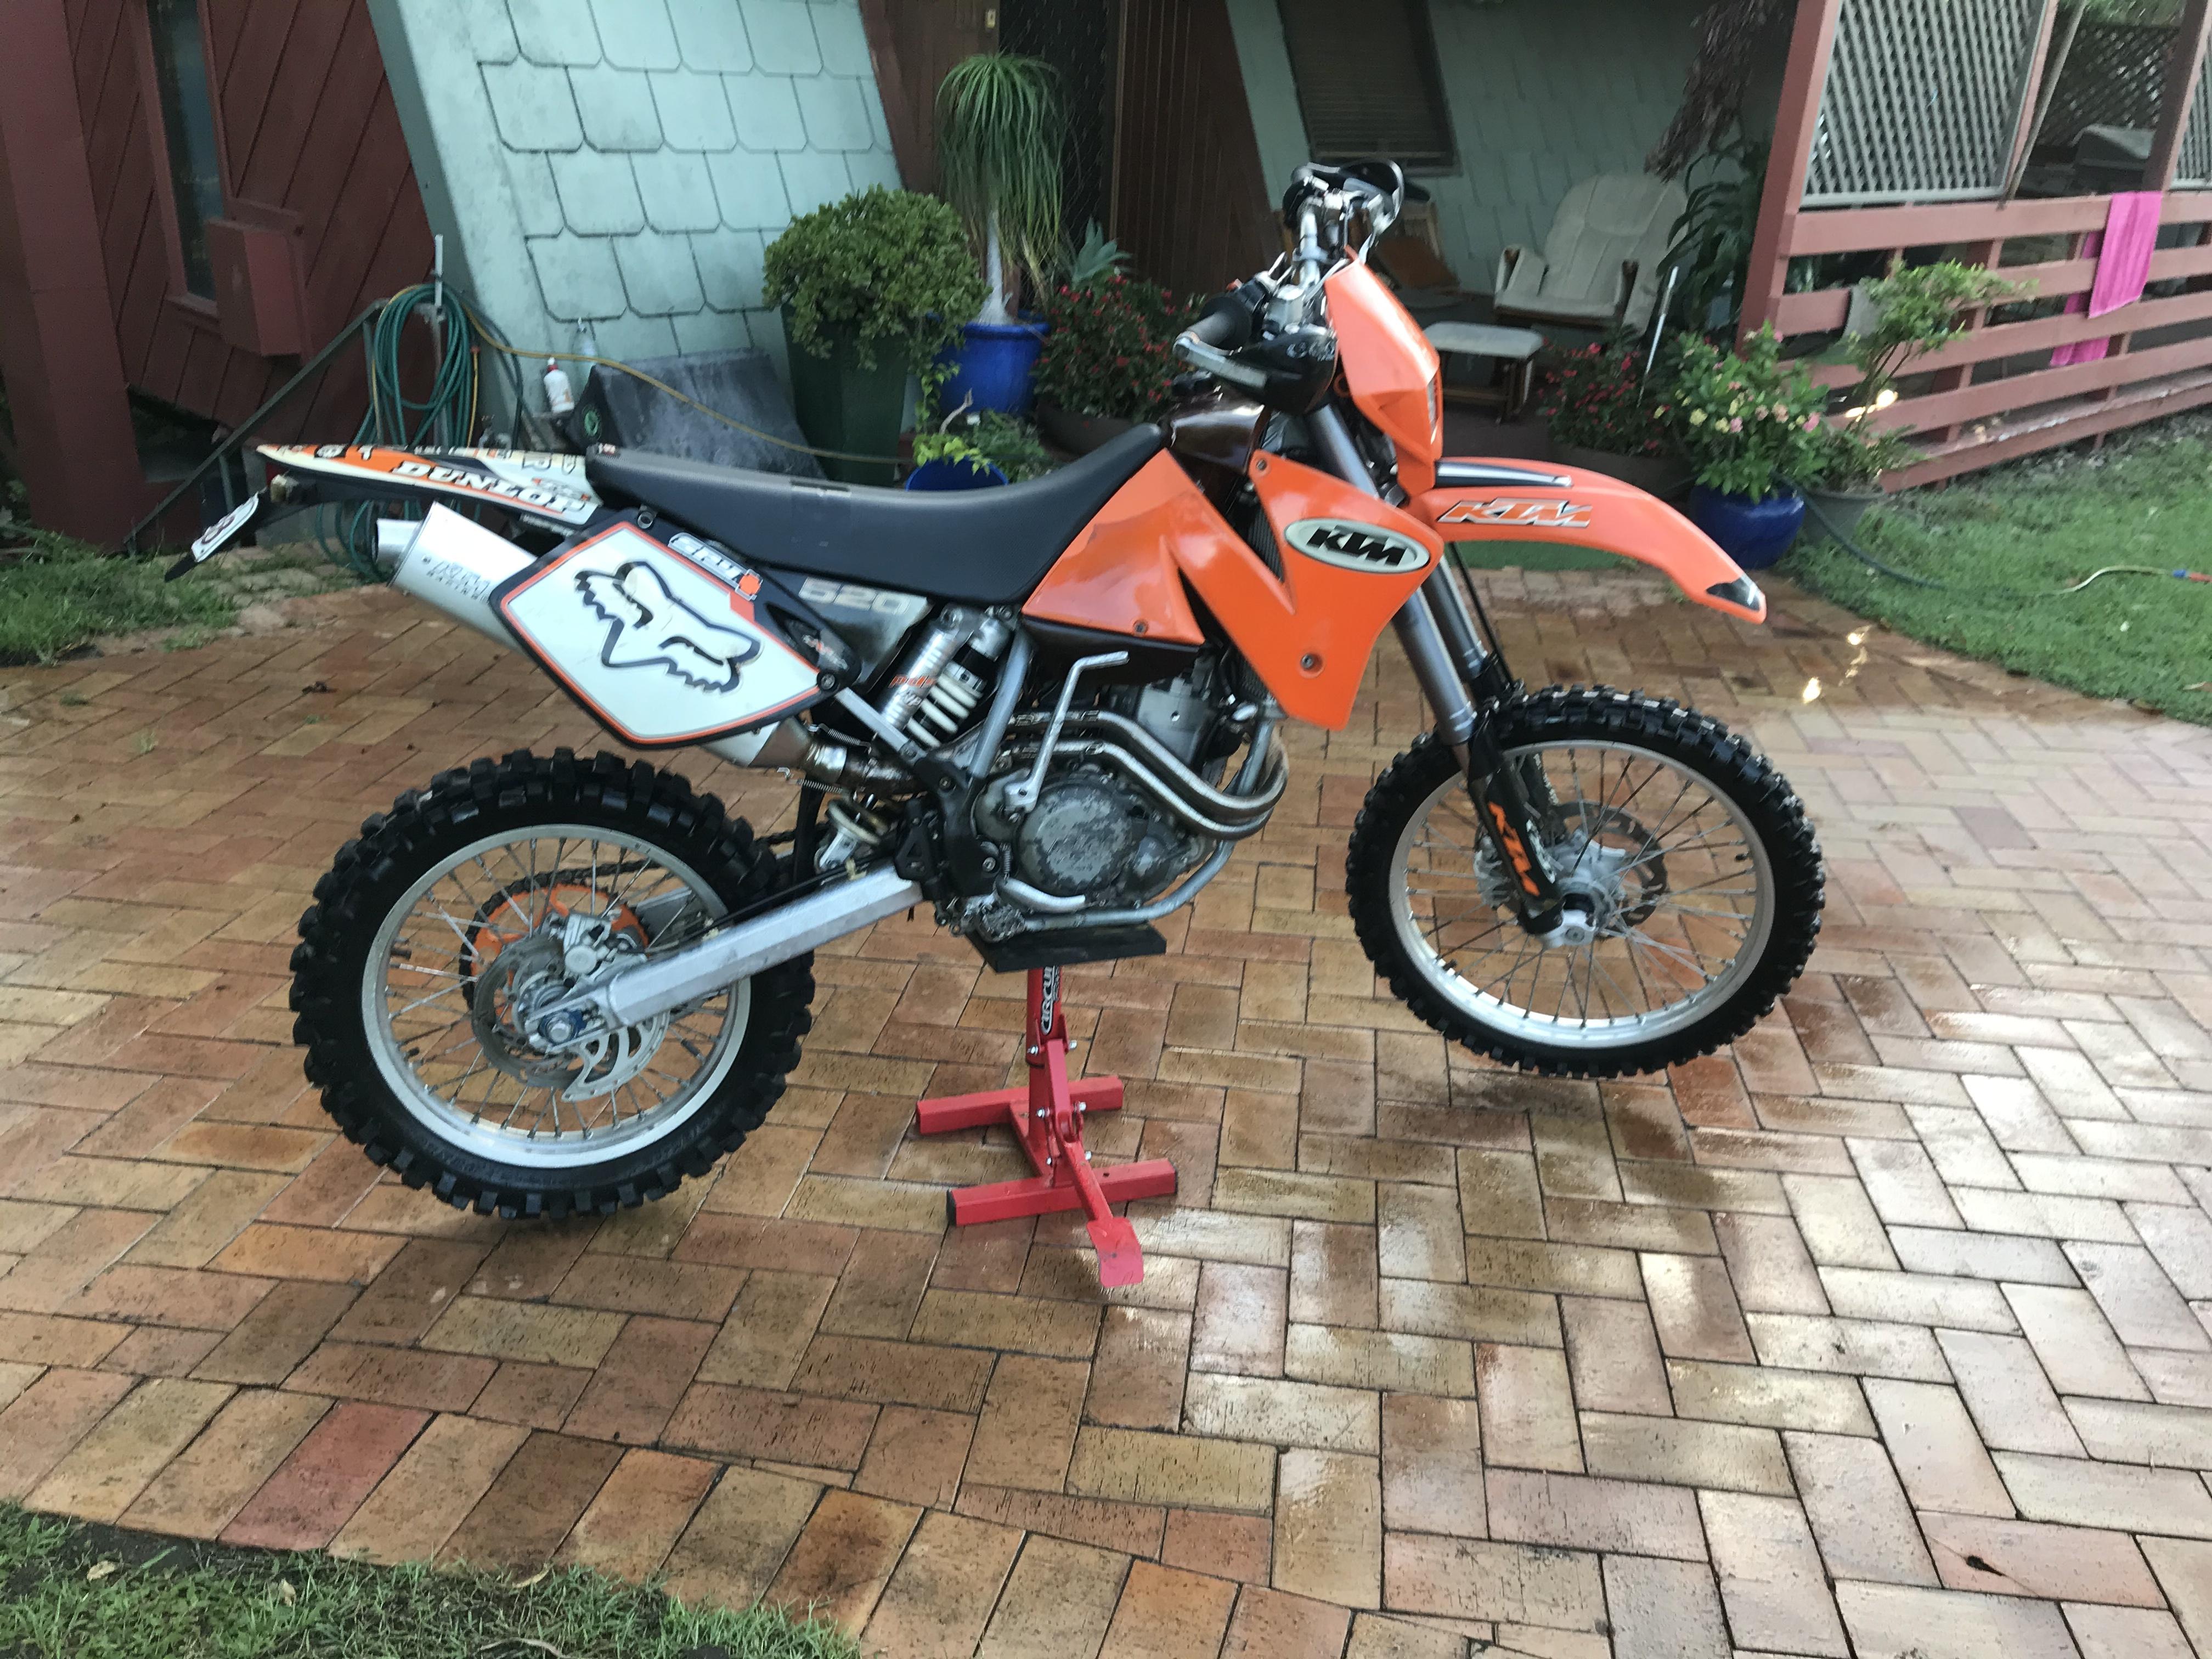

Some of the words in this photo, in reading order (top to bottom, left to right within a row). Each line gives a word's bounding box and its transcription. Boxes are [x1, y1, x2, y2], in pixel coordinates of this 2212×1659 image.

[391, 460, 586, 514] DUNLOP
[1435, 496, 1593, 528] KTM
[1306, 525, 1408, 567] KTM
[1041, 965, 1054, 1036] CIRCUI
